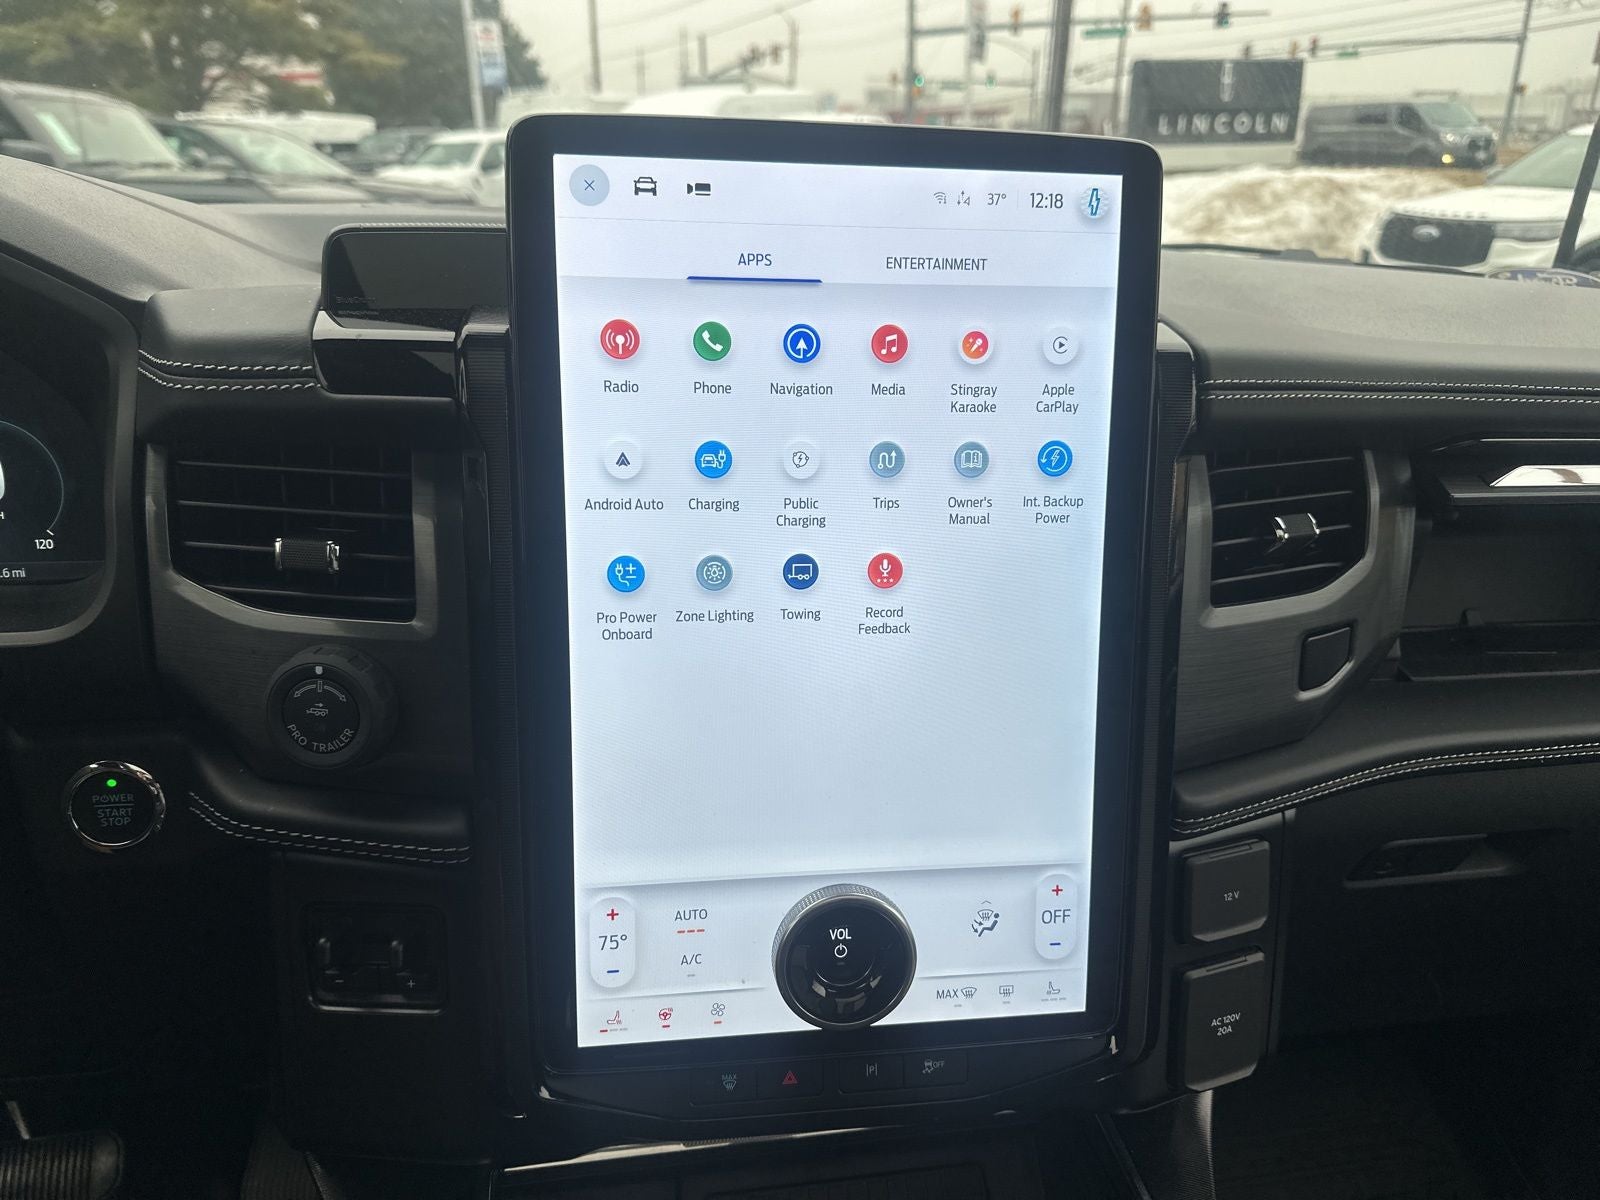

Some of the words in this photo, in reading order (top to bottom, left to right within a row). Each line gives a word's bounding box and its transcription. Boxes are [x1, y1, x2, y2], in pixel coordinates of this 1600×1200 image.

[1158, 110, 1289, 136] LINCOLN
[987, 193, 1007, 206] 37°
[1029, 193, 1064, 209] 12:18
[738, 253, 772, 267] APPS
[886, 256, 988, 271] ENTERTAINMENT
[603, 380, 639, 393] Radio
[693, 381, 732, 394] Phone
[770, 382, 833, 397] Navigation
[871, 383, 906, 396] Media
[950, 384, 997, 398] Stingray
[1042, 383, 1075, 397] Apple
[950, 401, 997, 413] Karaoke
[1036, 401, 1079, 415] CarPlay
[584, 498, 632, 510] Android
[635, 498, 664, 510] Auto
[688, 498, 740, 512] Charging
[783, 498, 819, 510] Public
[873, 497, 900, 511] Trips
[948, 496, 993, 508] Owner's
[1023, 495, 1041, 507] Int.
[1043, 496, 1084, 509] Backup
[776, 515, 826, 529] Charging
[949, 513, 990, 525] Manual
[1035, 512, 1071, 524] Power
[34, 539, 54, 550] 120
[12, 568, 26, 578] mi
[596, 612, 617, 624] Pro
[620, 611, 657, 624] Power
[676, 610, 705, 622] Zone
[708, 609, 754, 623] Lighting
[780, 608, 821, 622] Towing
[865, 606, 904, 619] Record
[602, 627, 652, 641] Onboard
[858, 622, 911, 635] Feedback
[287, 724, 307, 746] PRO
[311, 728, 354, 752] TRAILER
[91, 793, 135, 803] POWER
[97, 808, 133, 818] START
[101, 817, 131, 827] STOP
[1224, 892, 1233, 901] 12
[1234, 891, 1240, 899] V
[675, 909, 708, 921] AUTO
[1041, 909, 1071, 924] OFF
[830, 928, 852, 940] VOL
[599, 934, 628, 951] 75°
[680, 953, 702, 966] A/C
[936, 988, 959, 1000] MAX
[1211, 1018, 1221, 1027] AC
[1223, 1013, 1241, 1024] 120V
[1217, 1025, 1232, 1036] 20A
[933, 1061, 945, 1069] OFF
